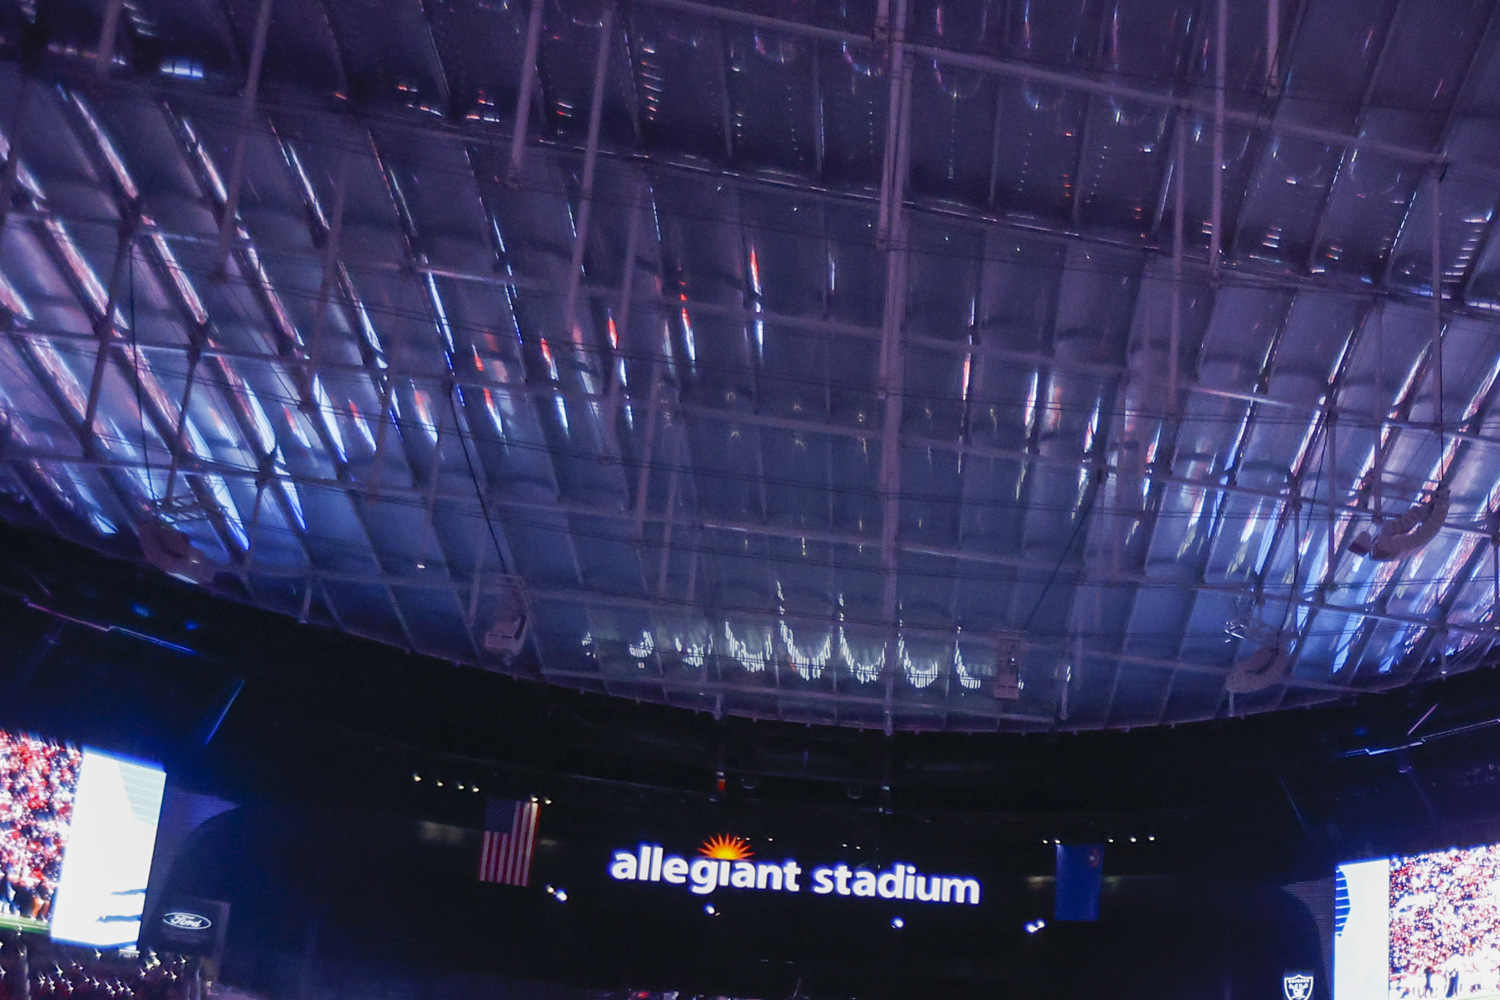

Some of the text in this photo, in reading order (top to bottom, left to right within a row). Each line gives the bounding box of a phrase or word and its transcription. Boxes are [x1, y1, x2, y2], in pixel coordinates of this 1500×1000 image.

[610, 846, 981, 904] allegiant stadium
[171, 914, 203, 927] Ford
